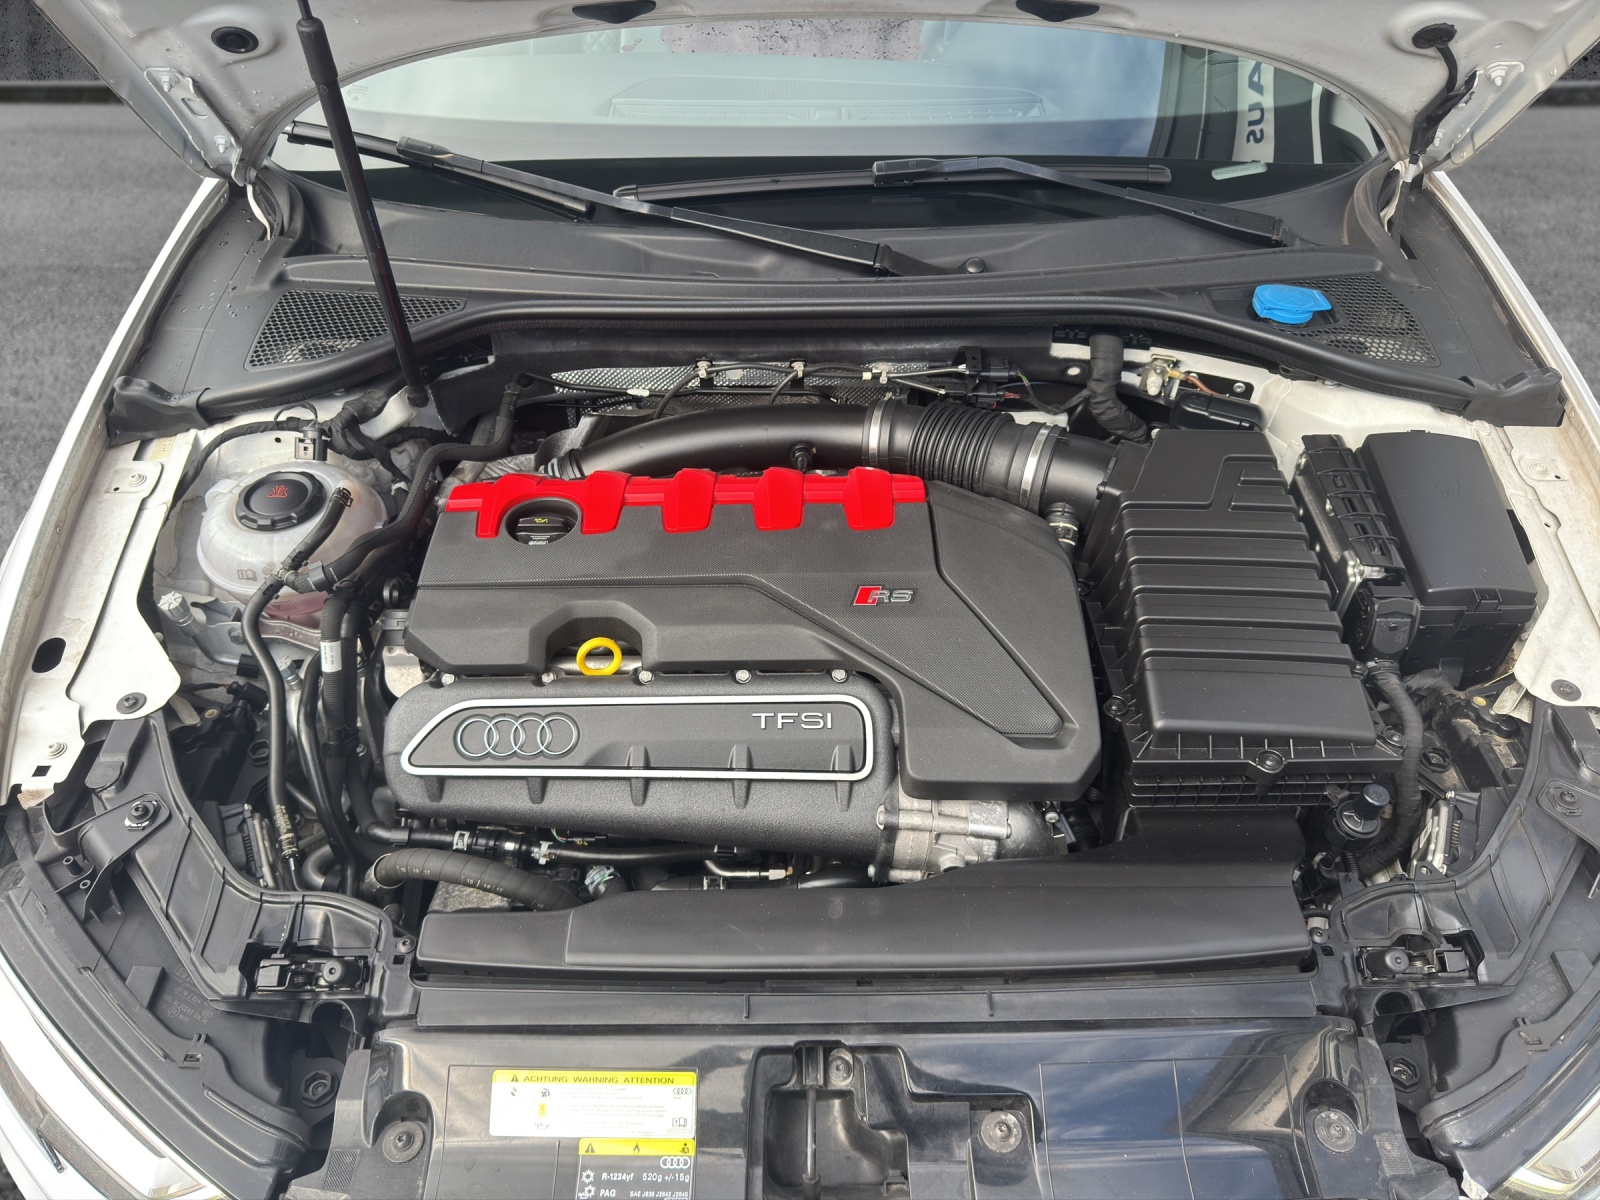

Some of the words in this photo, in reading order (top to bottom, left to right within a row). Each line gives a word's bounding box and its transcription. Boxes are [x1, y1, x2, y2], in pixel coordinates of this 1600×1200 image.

[867, 589, 914, 604] RS
[751, 712, 833, 730] TFSI
[523, 1075, 568, 1083] ACHTUNG
[623, 1076, 675, 1084] ATTENTION
[601, 1172, 634, 1182] R-1234yf
[642, 1172, 663, 1183] 520g
[599, 1188, 616, 1197] PAG
